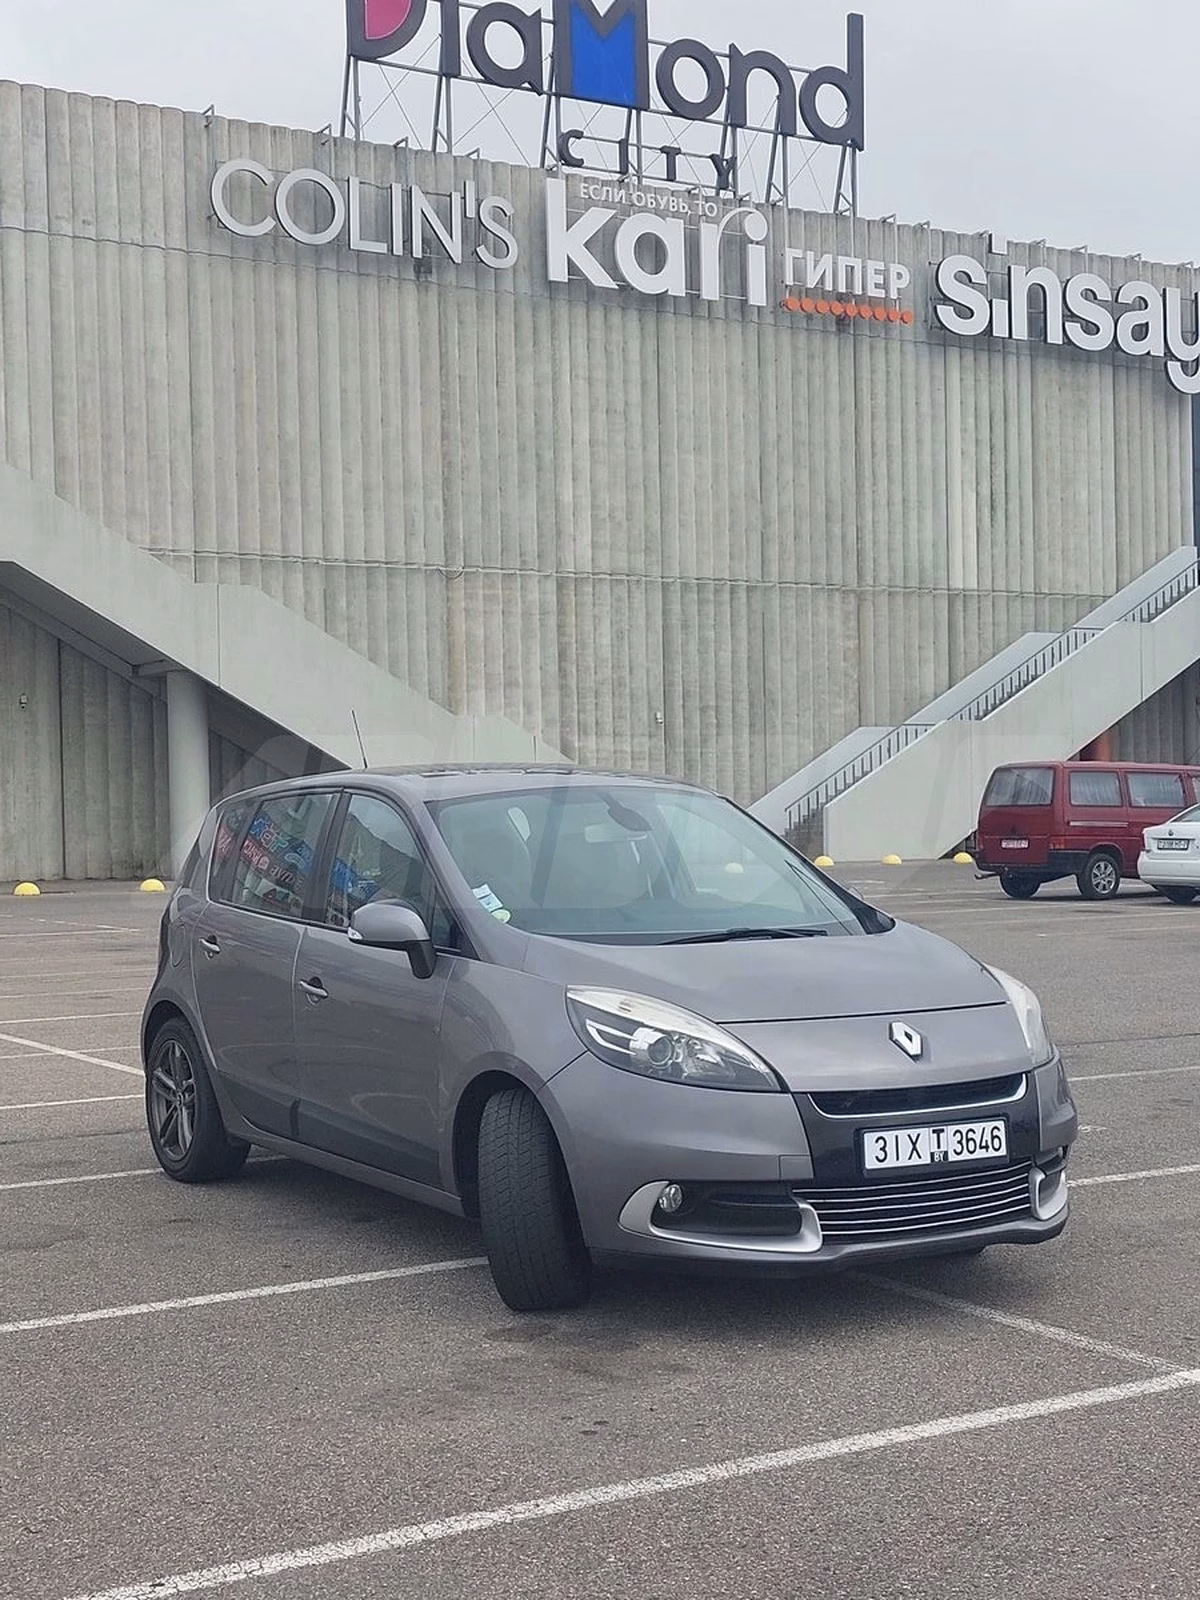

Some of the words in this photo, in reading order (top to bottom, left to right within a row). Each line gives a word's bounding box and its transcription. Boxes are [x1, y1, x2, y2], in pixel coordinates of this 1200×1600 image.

[557, 129, 737, 190] CITY
[211, 158, 518, 269] COLIN'S
[580, 183, 626, 204] ЕСЛИ
[632, 191, 692, 215] ОБУВЬ,
[694, 201, 718, 217] ТО
[546, 178, 768, 307] kari
[785, 247, 911, 300] ГИПЕР
